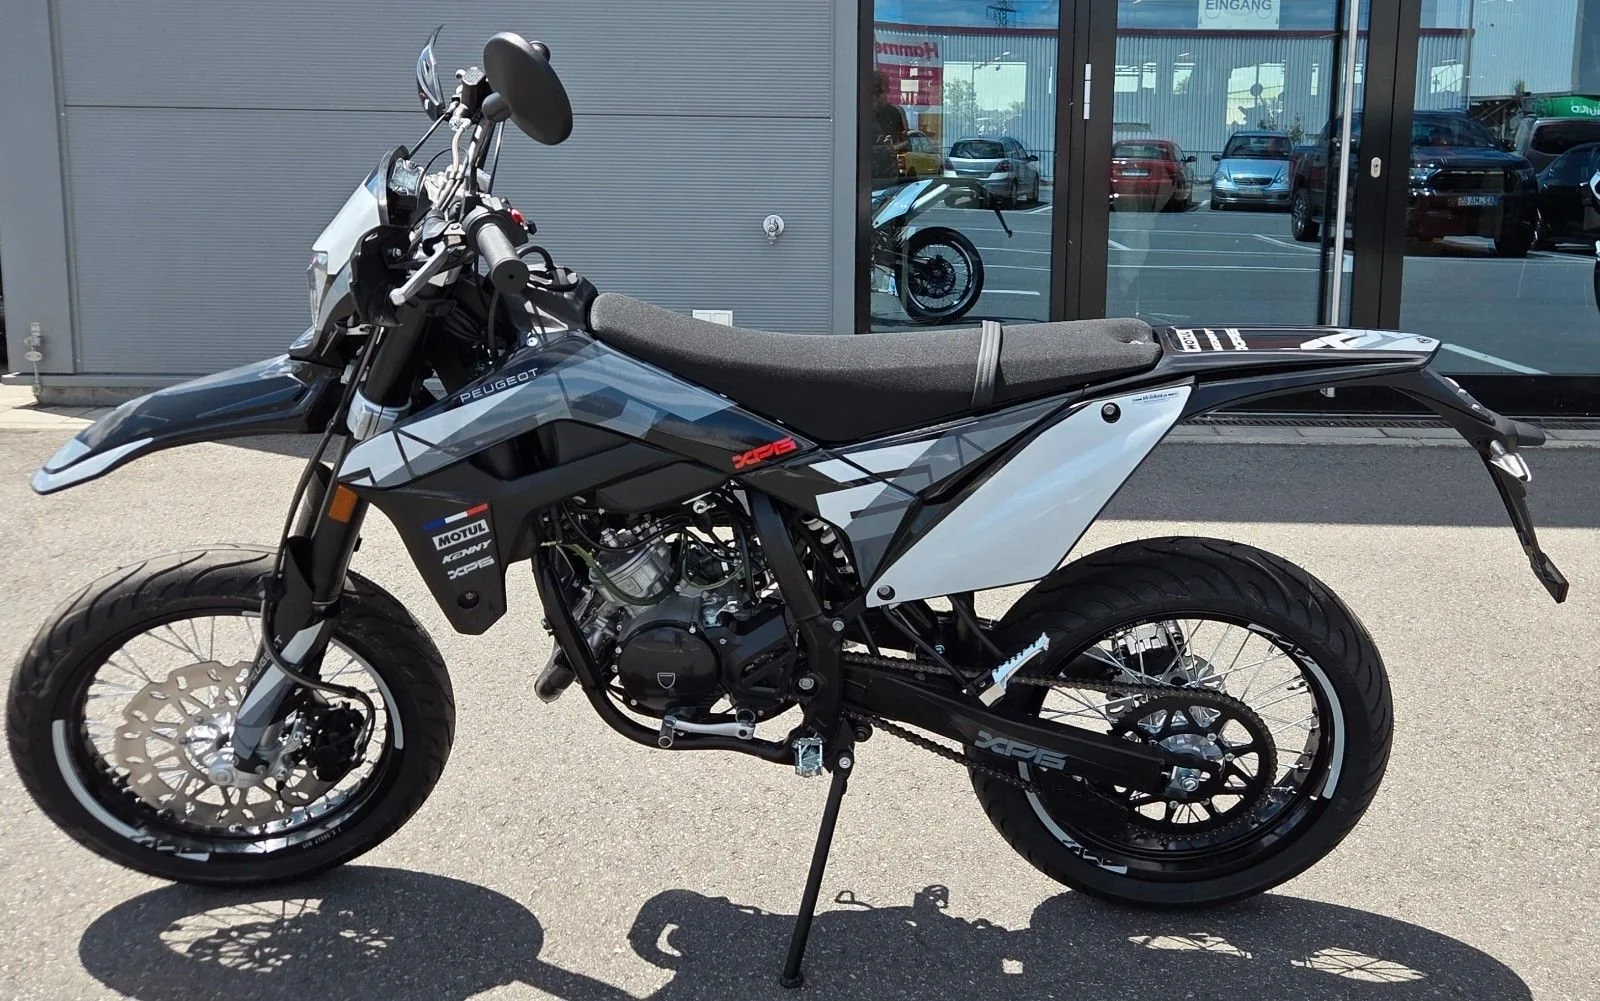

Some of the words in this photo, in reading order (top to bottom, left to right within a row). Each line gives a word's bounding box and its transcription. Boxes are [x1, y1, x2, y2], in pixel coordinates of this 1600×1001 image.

[1205, 0, 1272, 10] EINGANG
[459, 367, 539, 403] PEUGEOT
[437, 522, 486, 548] MOTUL
[441, 538, 492, 565] KENNY
